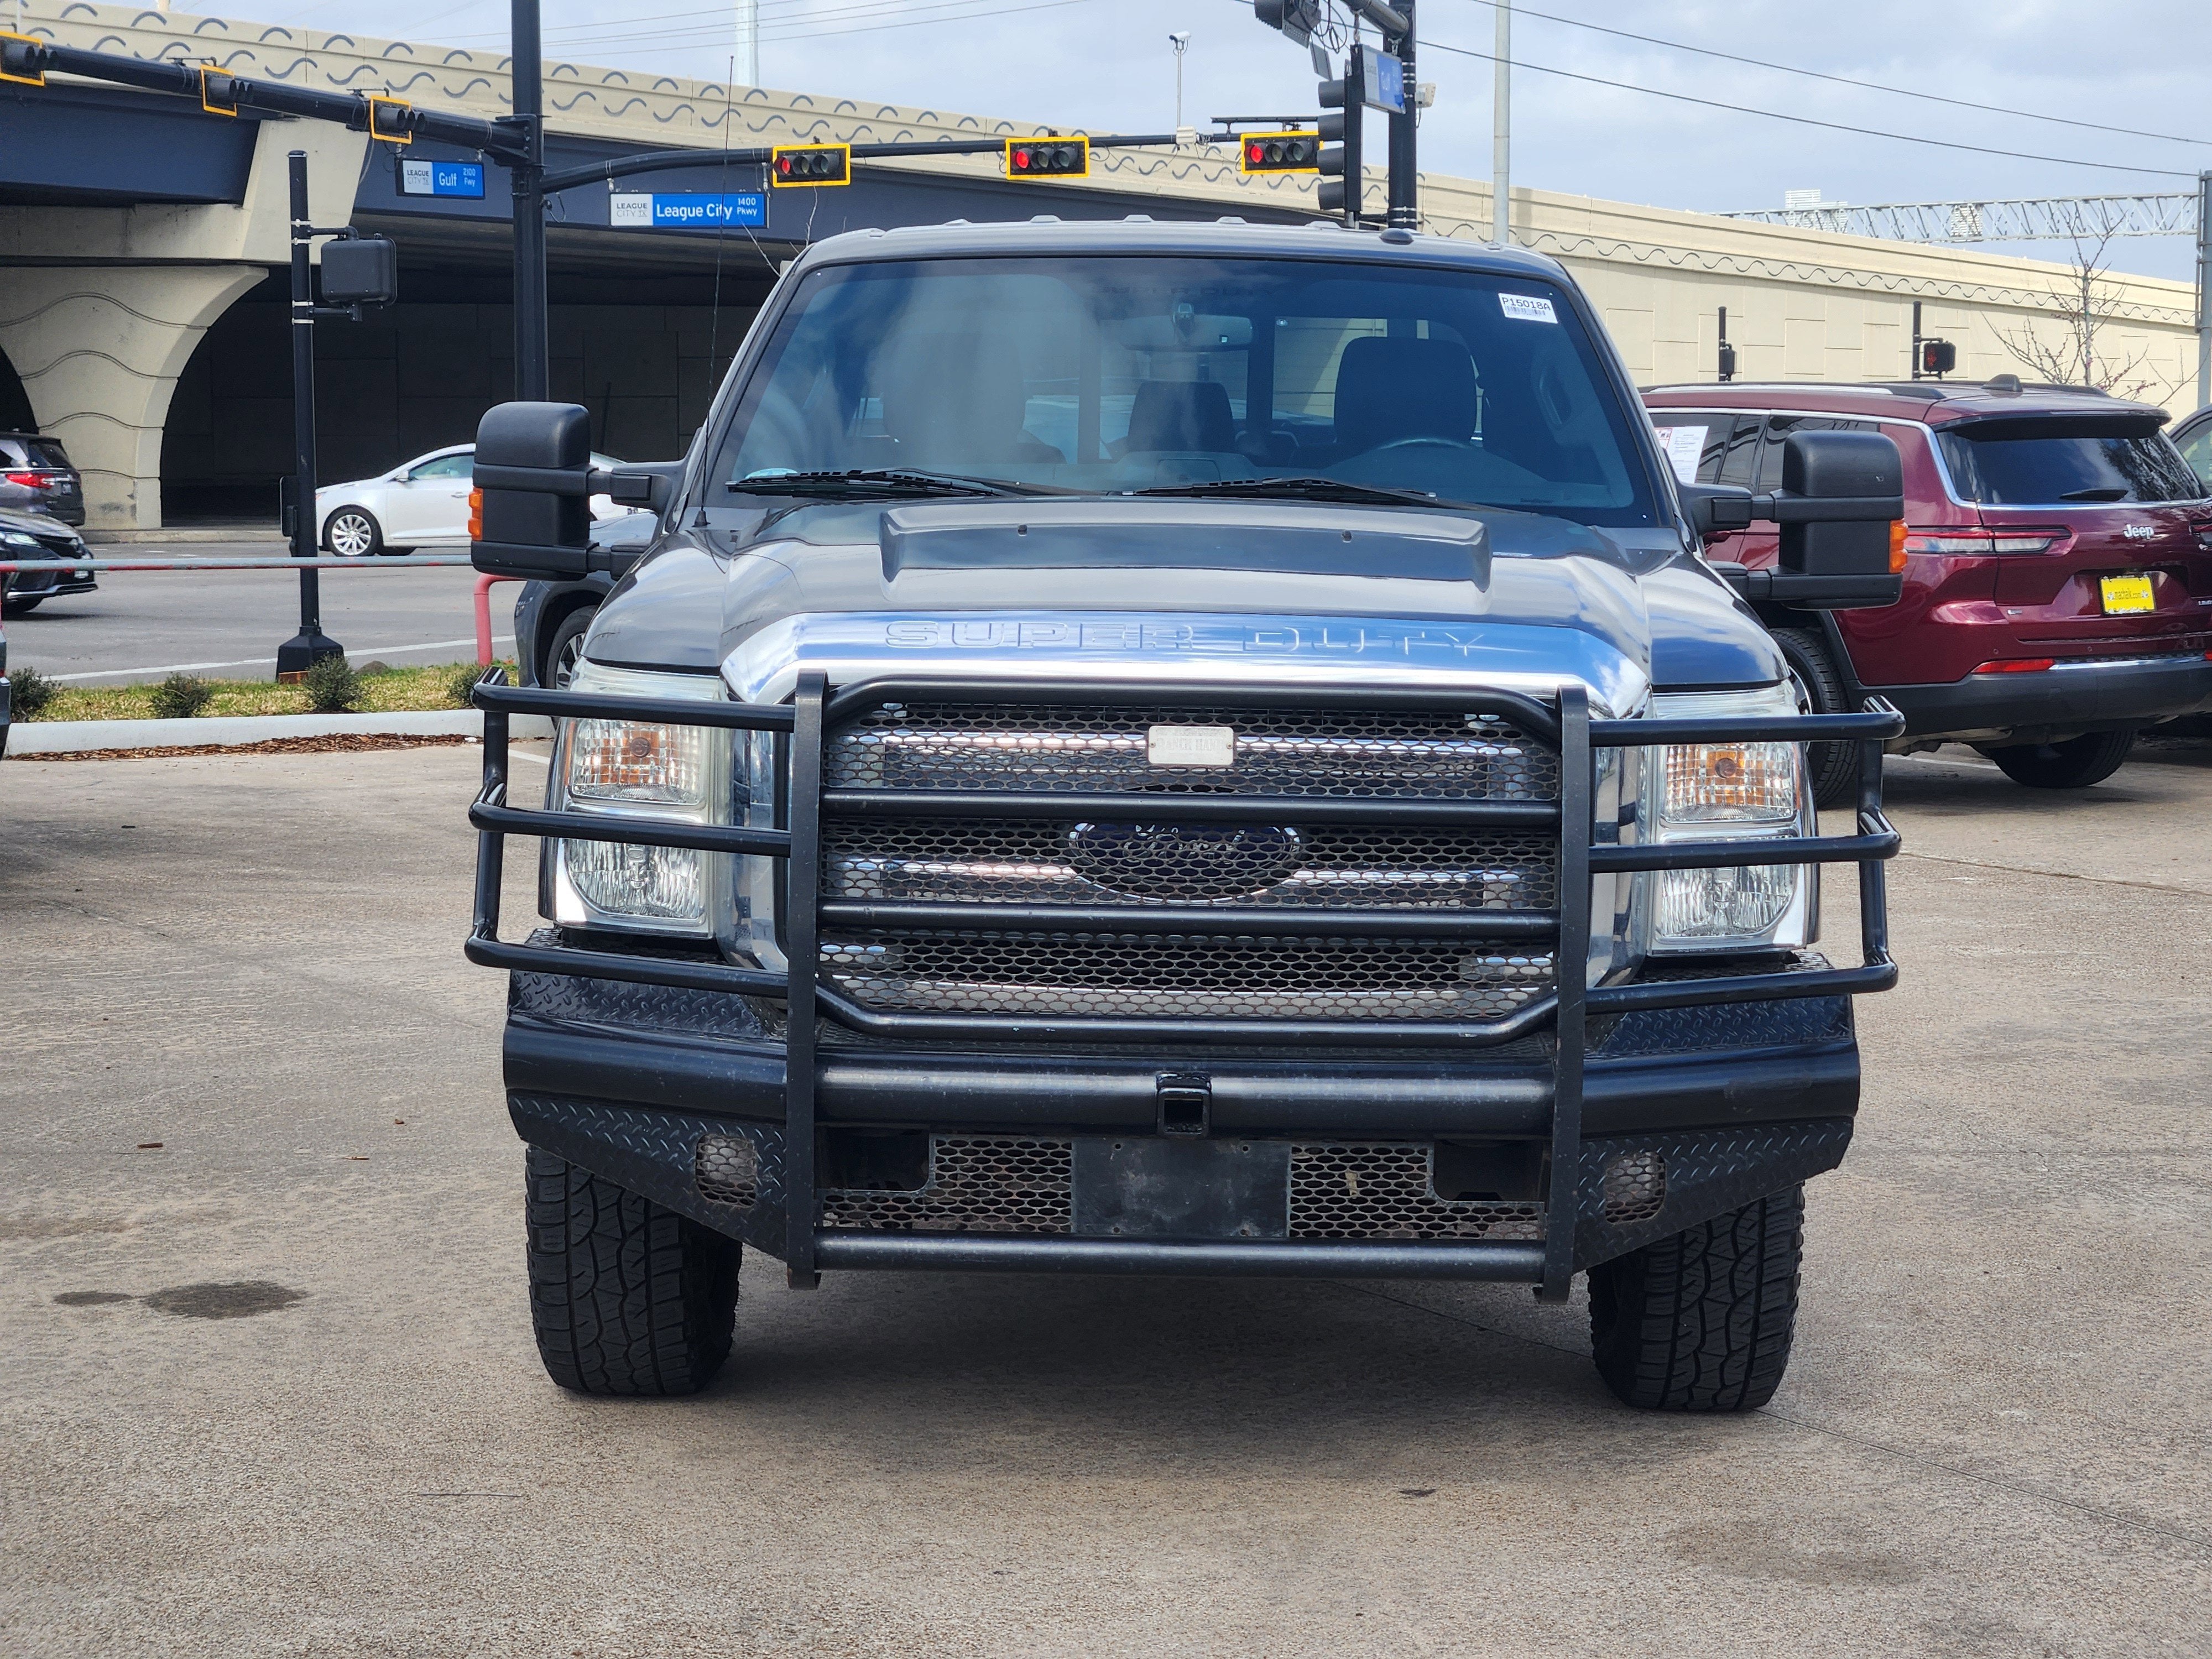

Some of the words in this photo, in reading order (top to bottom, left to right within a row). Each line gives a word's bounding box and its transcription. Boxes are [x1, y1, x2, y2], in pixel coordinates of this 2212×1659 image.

[463, 168, 476, 176] 2100
[439, 172, 457, 187] Gulf
[464, 178, 476, 187] Fwy
[738, 197, 756, 206] 1400
[656, 204, 703, 221] League
[706, 203, 733, 220] City
[737, 207, 757, 217] Pkwy
[1502, 297, 1551, 311] P15018A
[2124, 524, 2154, 540] Jeep
[885, 620, 1193, 649] SUPER
[1243, 625, 1486, 657] DUTY
